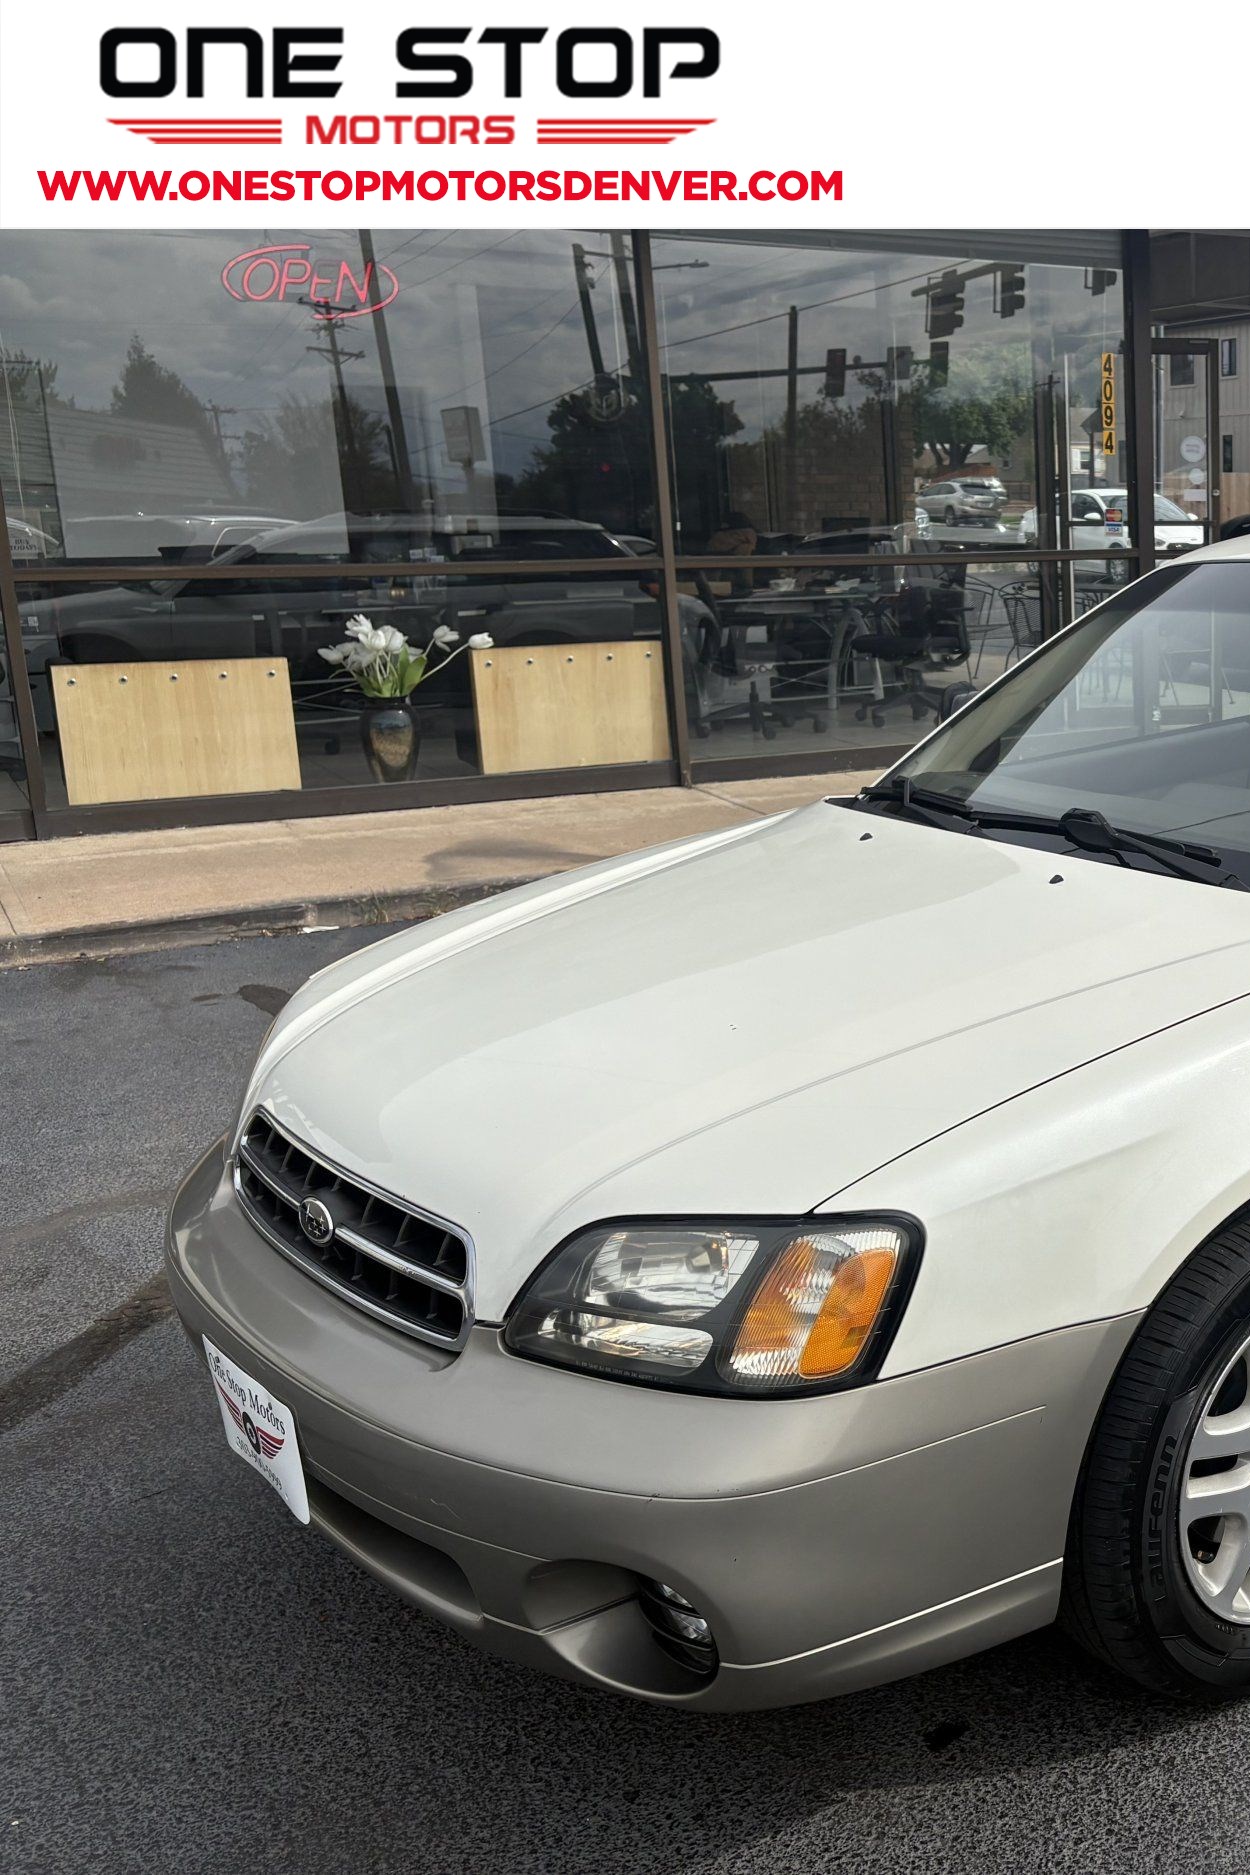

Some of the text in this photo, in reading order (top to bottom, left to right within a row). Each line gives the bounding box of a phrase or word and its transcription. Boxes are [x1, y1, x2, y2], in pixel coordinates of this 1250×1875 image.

[242, 257, 373, 303] OPEN
[1103, 354, 1114, 454] 4094
[208, 1352, 286, 1435] One Stop Motors
